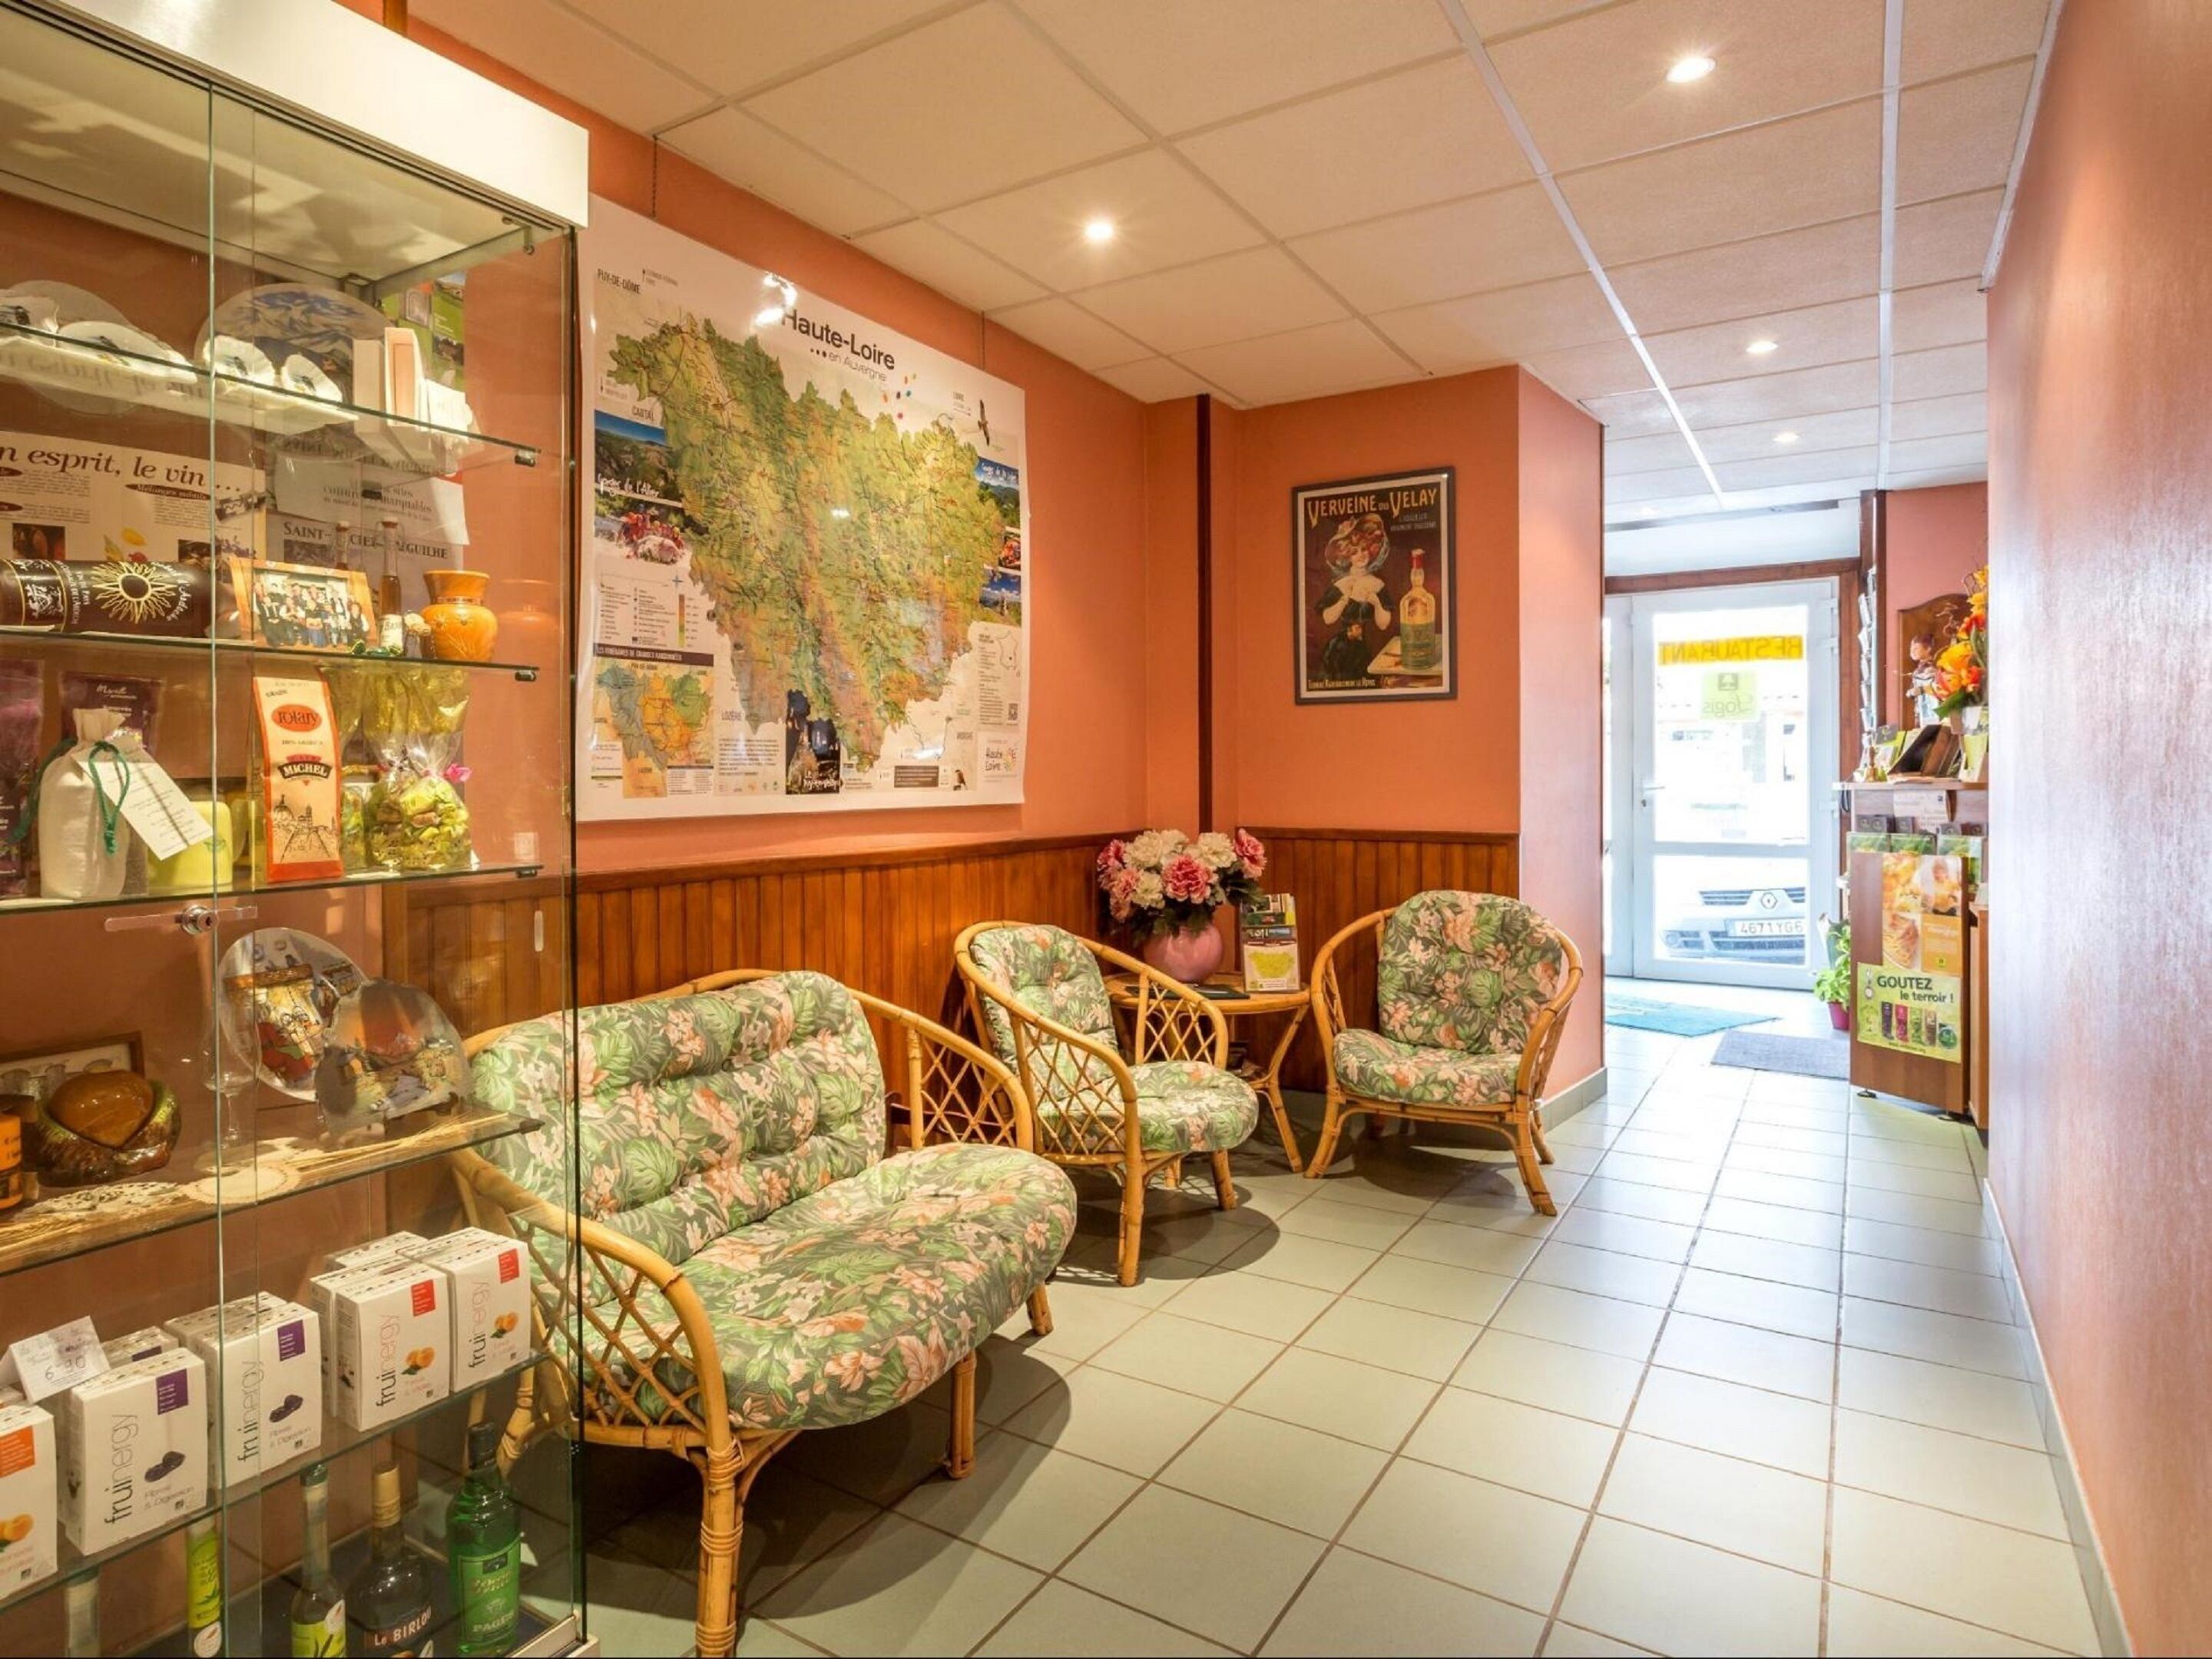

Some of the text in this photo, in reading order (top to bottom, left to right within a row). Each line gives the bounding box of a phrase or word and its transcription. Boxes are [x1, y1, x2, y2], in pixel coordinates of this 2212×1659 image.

[780, 309, 895, 370] Haute-Loire
[28, 449, 121, 477] esprit,
[133, 455, 157, 479] le
[165, 464, 206, 487] vin
[1307, 494, 1378, 528] VERVEINE
[1389, 488, 1437, 520] VELAY
[282, 763, 329, 777] MICHEL
[1876, 975, 1933, 991] GOUTEZ
[1899, 990, 1910, 1001] le
[1912, 991, 1947, 1003] terroir
